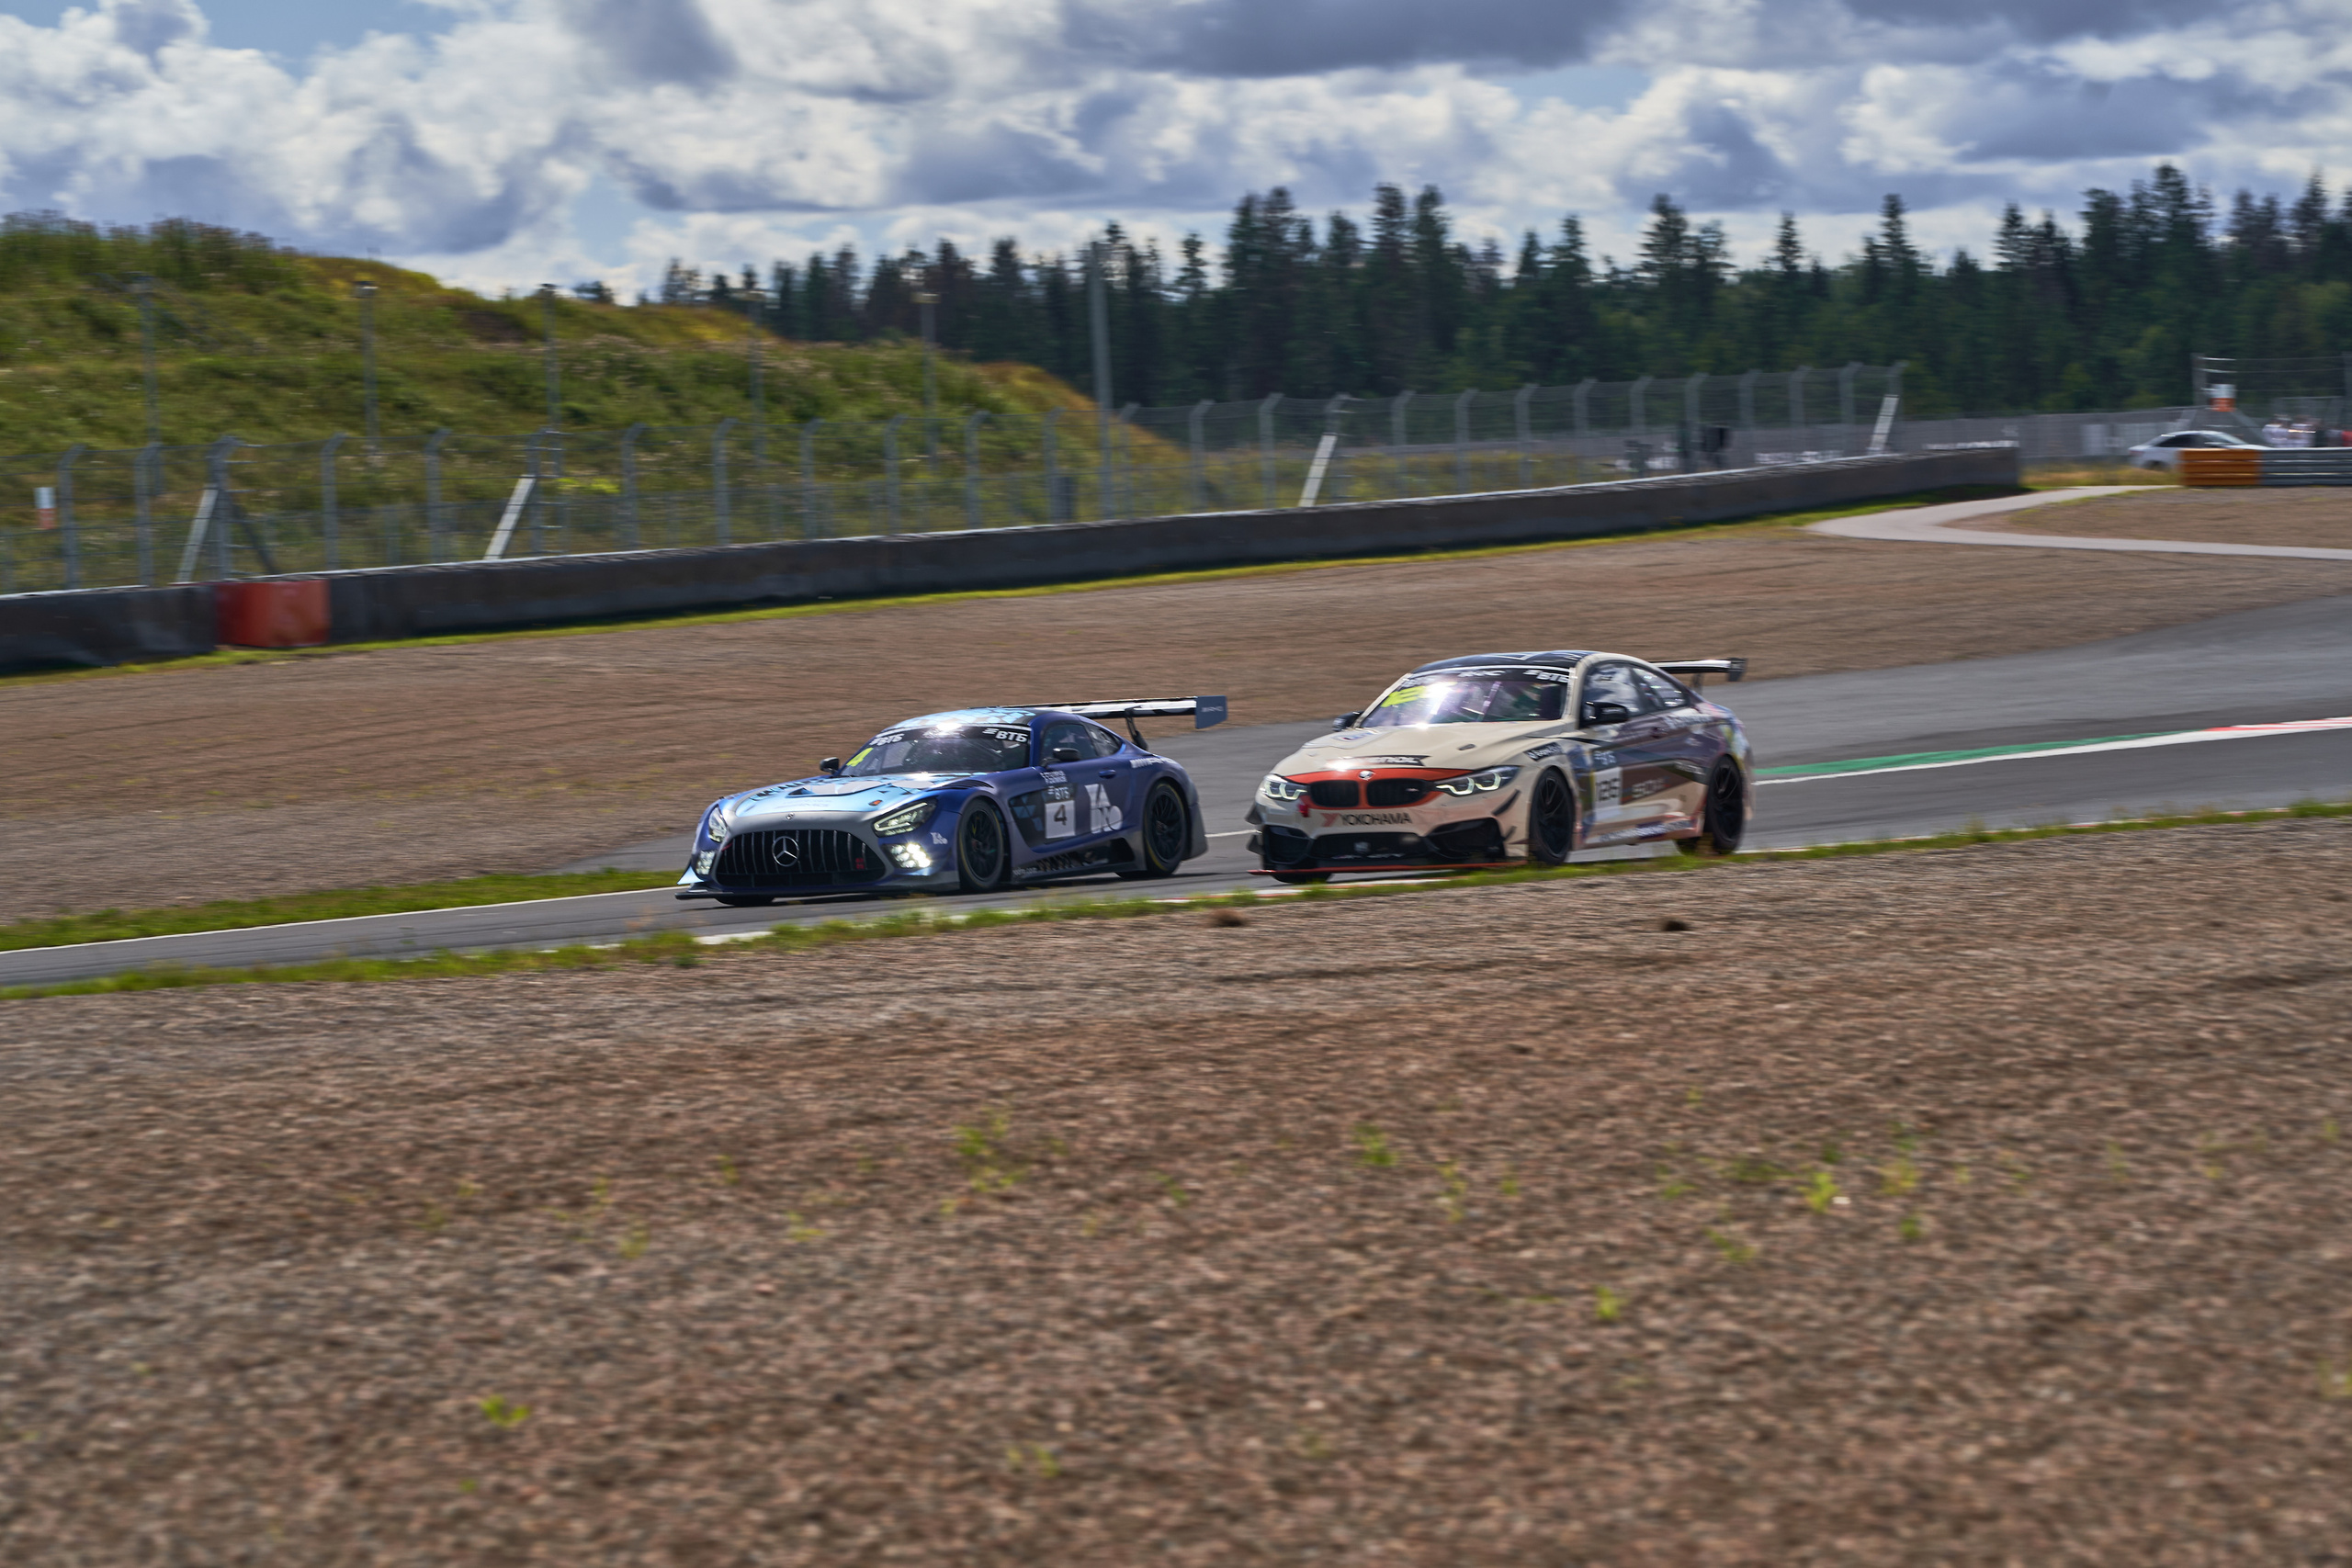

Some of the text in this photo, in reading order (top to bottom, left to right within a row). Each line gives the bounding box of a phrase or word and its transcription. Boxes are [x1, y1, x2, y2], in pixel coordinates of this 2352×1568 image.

[995, 730, 1029, 743] ВТБ
[1055, 786, 1070, 800] ВТБ
[1054, 804, 1068, 826] 4
[1340, 812, 1413, 826] YOKOHAMA
